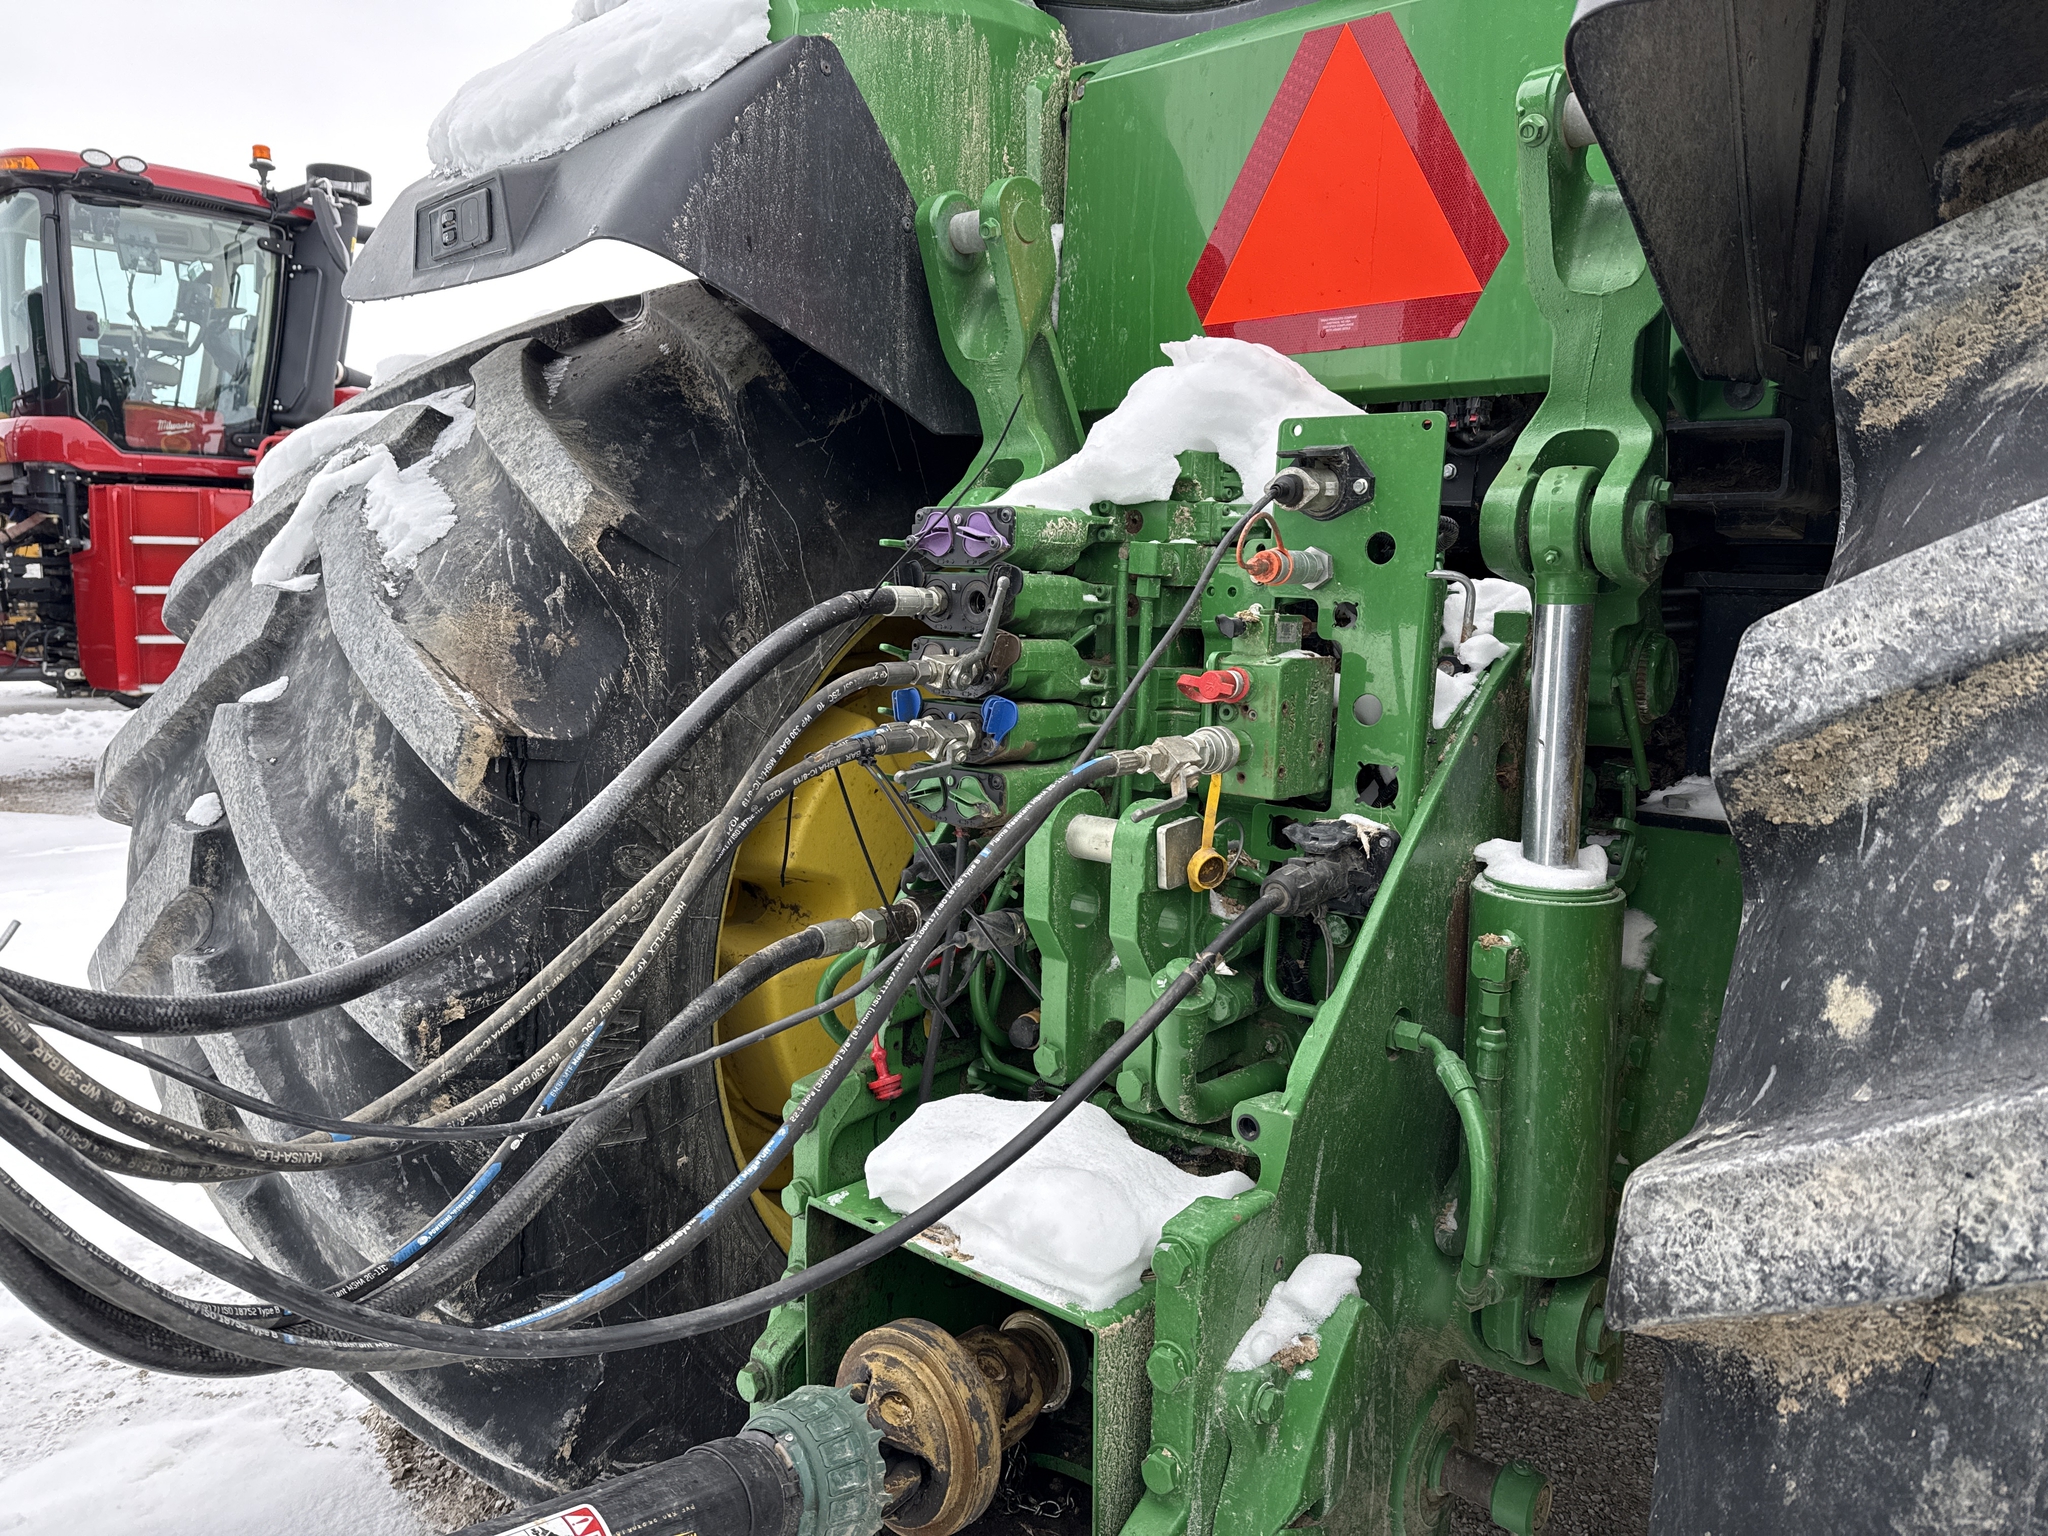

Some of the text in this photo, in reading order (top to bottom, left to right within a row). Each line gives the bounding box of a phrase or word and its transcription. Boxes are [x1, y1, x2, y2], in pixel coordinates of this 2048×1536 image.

[157, 419, 196, 432] Milwaukee
[828, 688, 842, 702] 2SC
[816, 702, 826, 712] 10
[801, 713, 813, 729] WP
[790, 726, 801, 740] 330
[776, 737, 792, 756] BAR
[846, 750, 862, 762] BAR
[757, 757, 777, 781] MSHA
[820, 757, 841, 772] MSHA
[793, 767, 819, 786] IC-8/19
[765, 787, 785, 803] 1Q21
[989, 823, 1010, 847] Flame
[1009, 802, 1033, 828] Resistant
[1031, 788, 1050, 807] MSHA
[615, 914, 628, 927] EN
[647, 900, 687, 955] HANSA-FLEX
[637, 958, 648, 974] KP
[547, 973, 565, 987] WP
[624, 970, 638, 987] 210
[536, 985, 551, 1001] 330
[610, 989, 623, 1004] EN
[789, 1107, 804, 1123] 22.5
[802, 1090, 816, 1107] MPa
[814, 1069, 831, 1092] (3250
[829, 1054, 844, 1071] PSI)
[851, 1024, 863, 1040] (9.5
[860, 1007, 875, 1025] mm)
[872, 994, 882, 1008] ISO
[880, 972, 896, 995] 11237
[895, 957, 906, 973] R17
[907, 937, 920, 953] SAE
[937, 897, 949, 913] ISO
[947, 878, 965, 897] 18752
[962, 864, 977, 879] Type
[518, 998, 537, 1017] BAR
[599, 1002, 612, 1019] 857
[0, 1005, 32, 1045] MSHA
[491, 1017, 517, 1040] MSHA
[581, 1016, 598, 1036] 2SC
[568, 1038, 578, 1049] 10
[32, 1037, 62, 1071] BAR
[547, 1053, 562, 1069] WP
[58, 1068, 83, 1087] 330
[531, 1064, 547, 1080] 330
[78, 1082, 102, 1102] WP
[511, 1077, 532, 1096] BAR
[111, 1100, 126, 1116] 10
[478, 1093, 507, 1115] MSHA
[252, 1147, 323, 1164] HANSA-FLEX
[151, 1161, 171, 1176] 330
[170, 1164, 191, 1178] WP
[347, 1277, 365, 1293] MSHA
[221, 1306, 234, 1316] ISO
[234, 1305, 257, 1317] 18752
[257, 1306, 275, 1317] Type
[274, 1305, 281, 1314] B
[218, 1313, 248, 1331] 18752
[250, 1325, 271, 1339] Type
[271, 1330, 279, 1340] B
